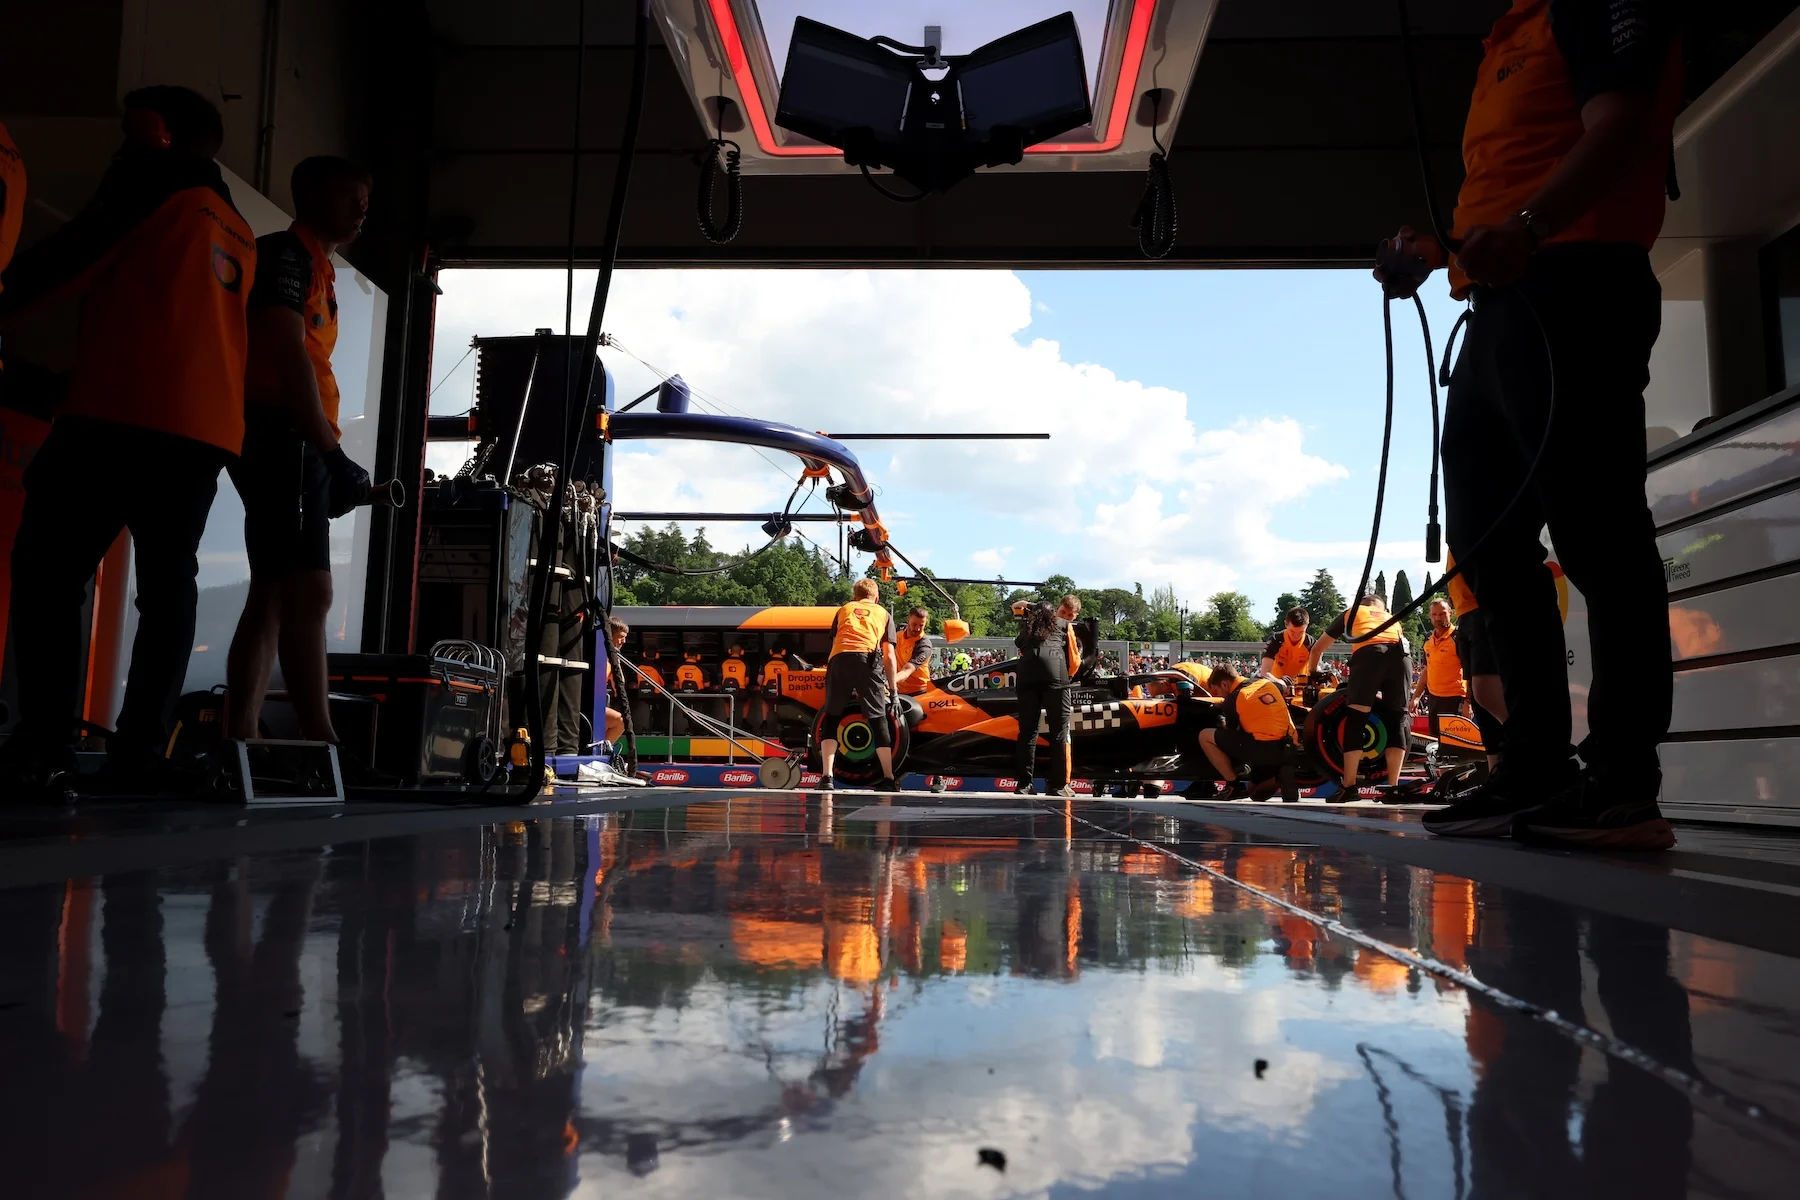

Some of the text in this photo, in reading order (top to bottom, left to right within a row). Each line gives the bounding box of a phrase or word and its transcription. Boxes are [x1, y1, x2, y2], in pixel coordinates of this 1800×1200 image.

[196, 206, 255, 252] McLaren
[277, 276, 301, 289] okta
[1671, 562, 1691, 574] Greene
[1671, 569, 1691, 581] Tweed
[788, 674, 826, 683] Dropbox
[788, 683, 812, 691] Dash
[929, 699, 958, 709] DELL
[1444, 724, 1471, 733] workday
[656, 772, 686, 781] Barilla
[723, 773, 754, 783] Barilla
[801, 774, 821, 783] arilla
